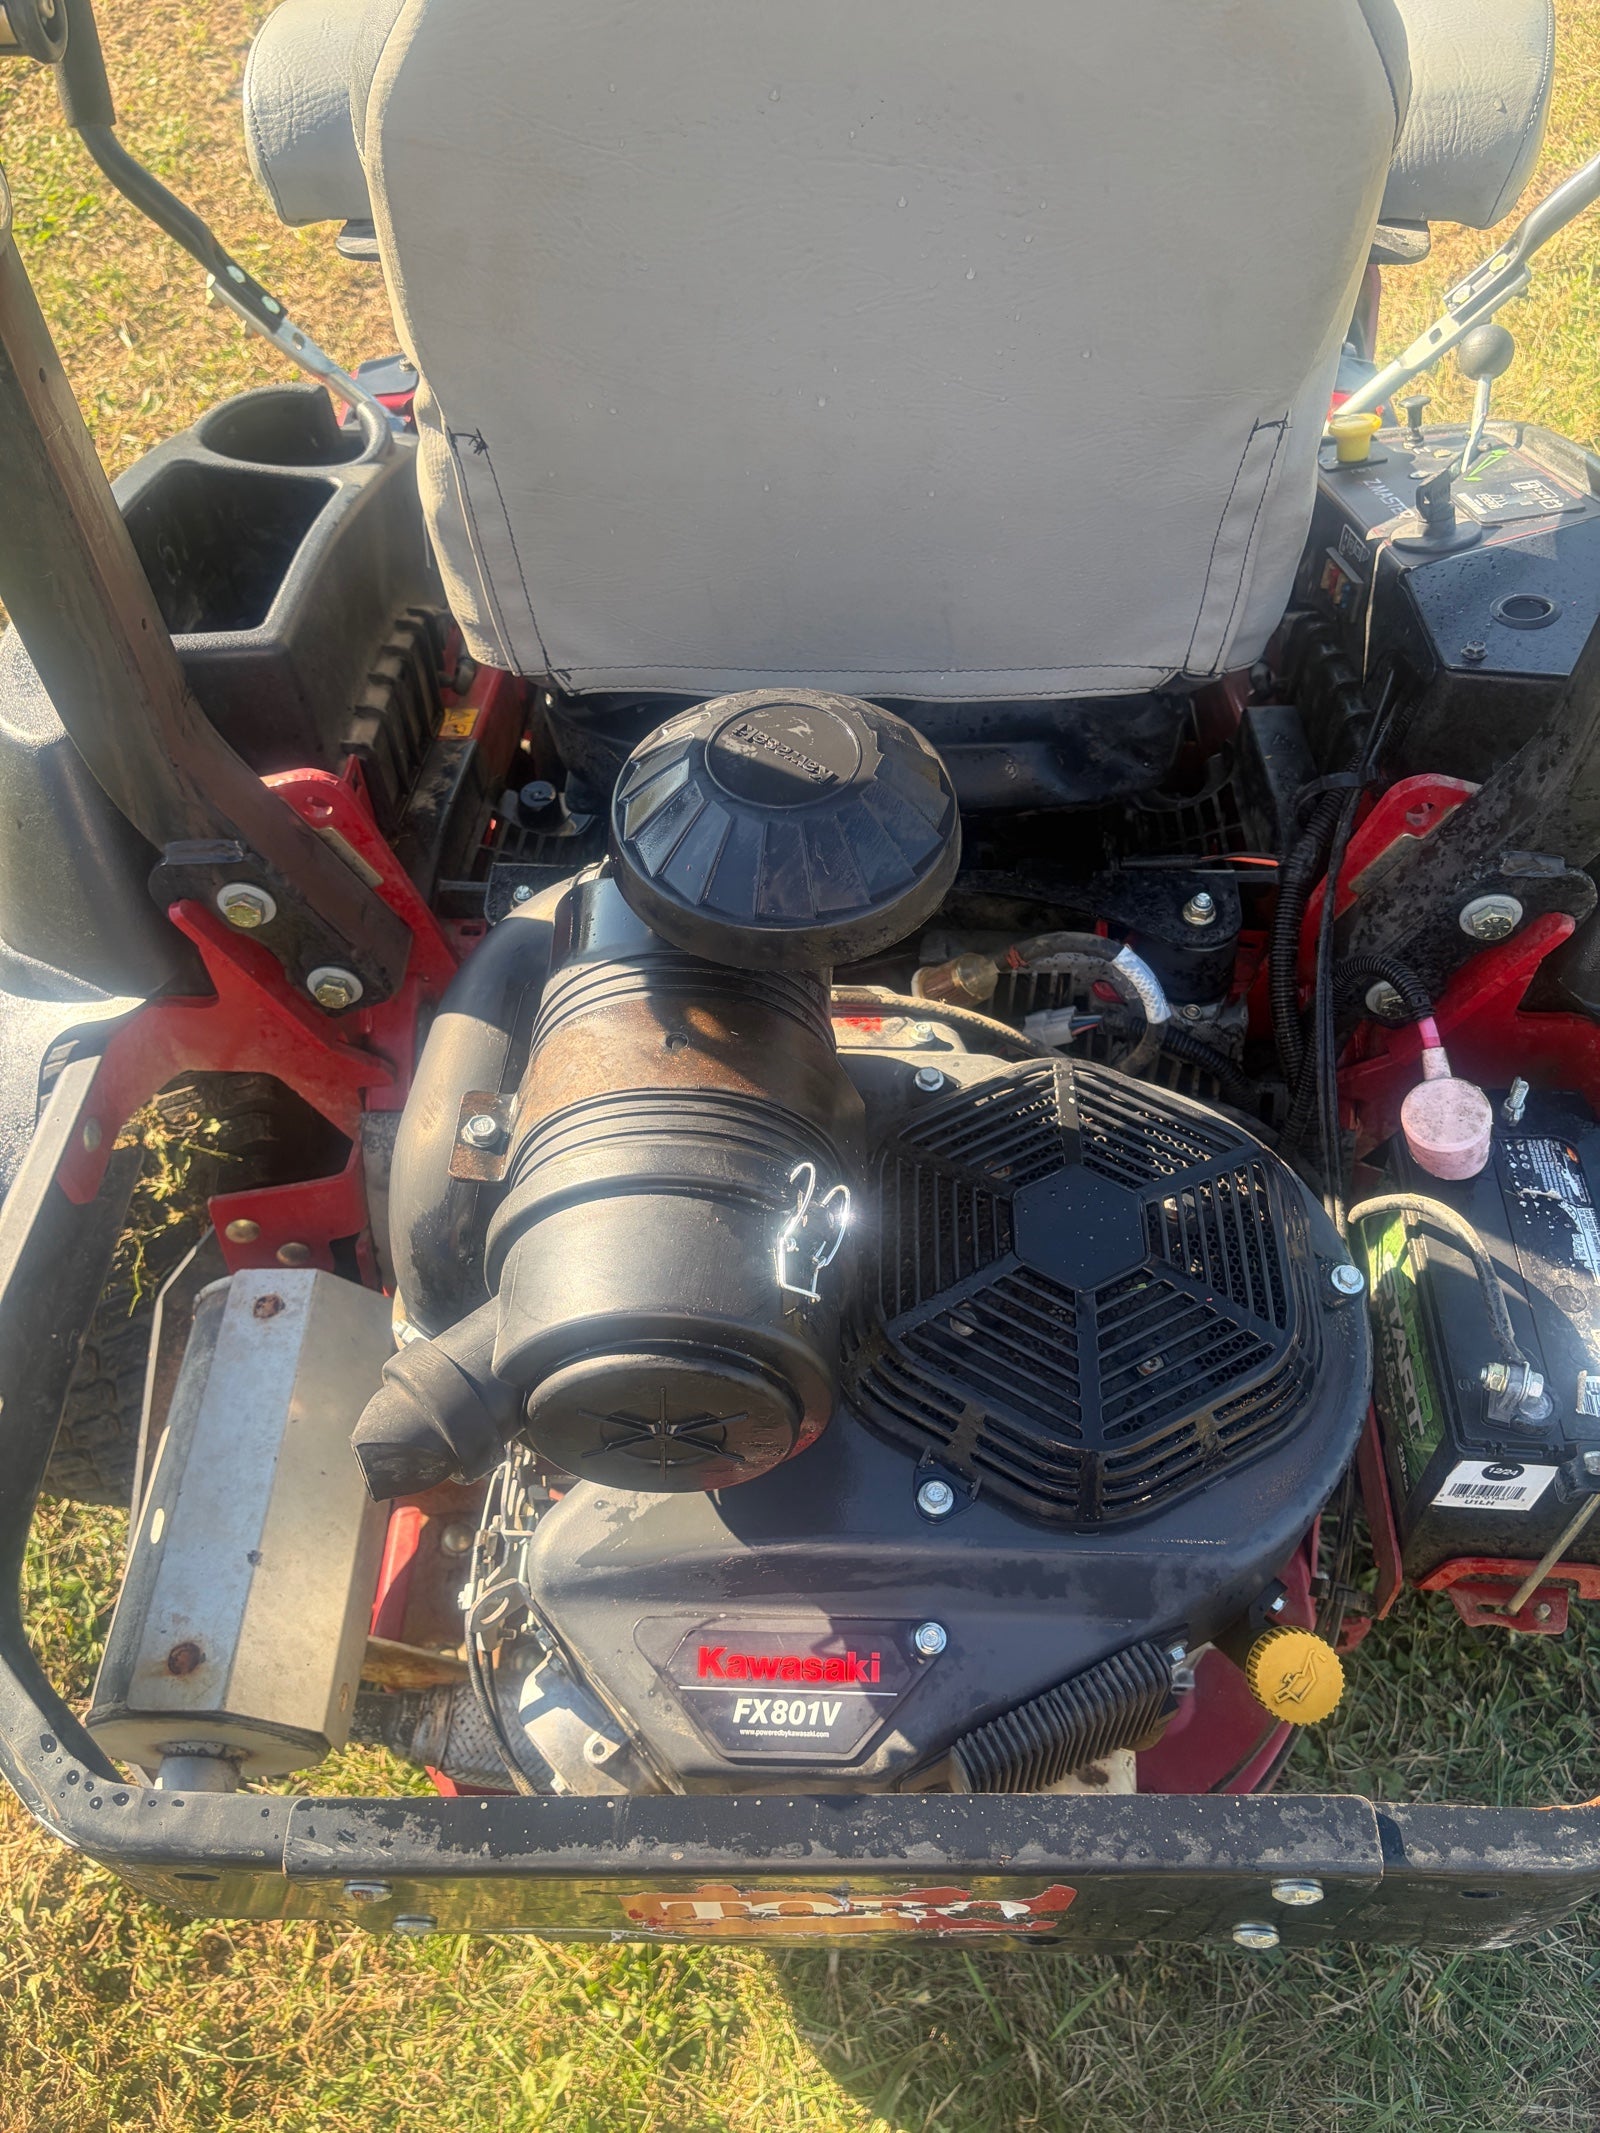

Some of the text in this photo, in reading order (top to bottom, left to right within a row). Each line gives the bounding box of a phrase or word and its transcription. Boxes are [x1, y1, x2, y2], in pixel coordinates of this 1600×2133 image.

[1382, 1251, 1425, 1436] START
[1488, 1467, 1519, 1476] 12/24
[696, 1646, 881, 1683] Kawasaki
[732, 1699, 842, 1726] FX801V
[739, 1728, 830, 1738] www.poweredbykawasaki.com
